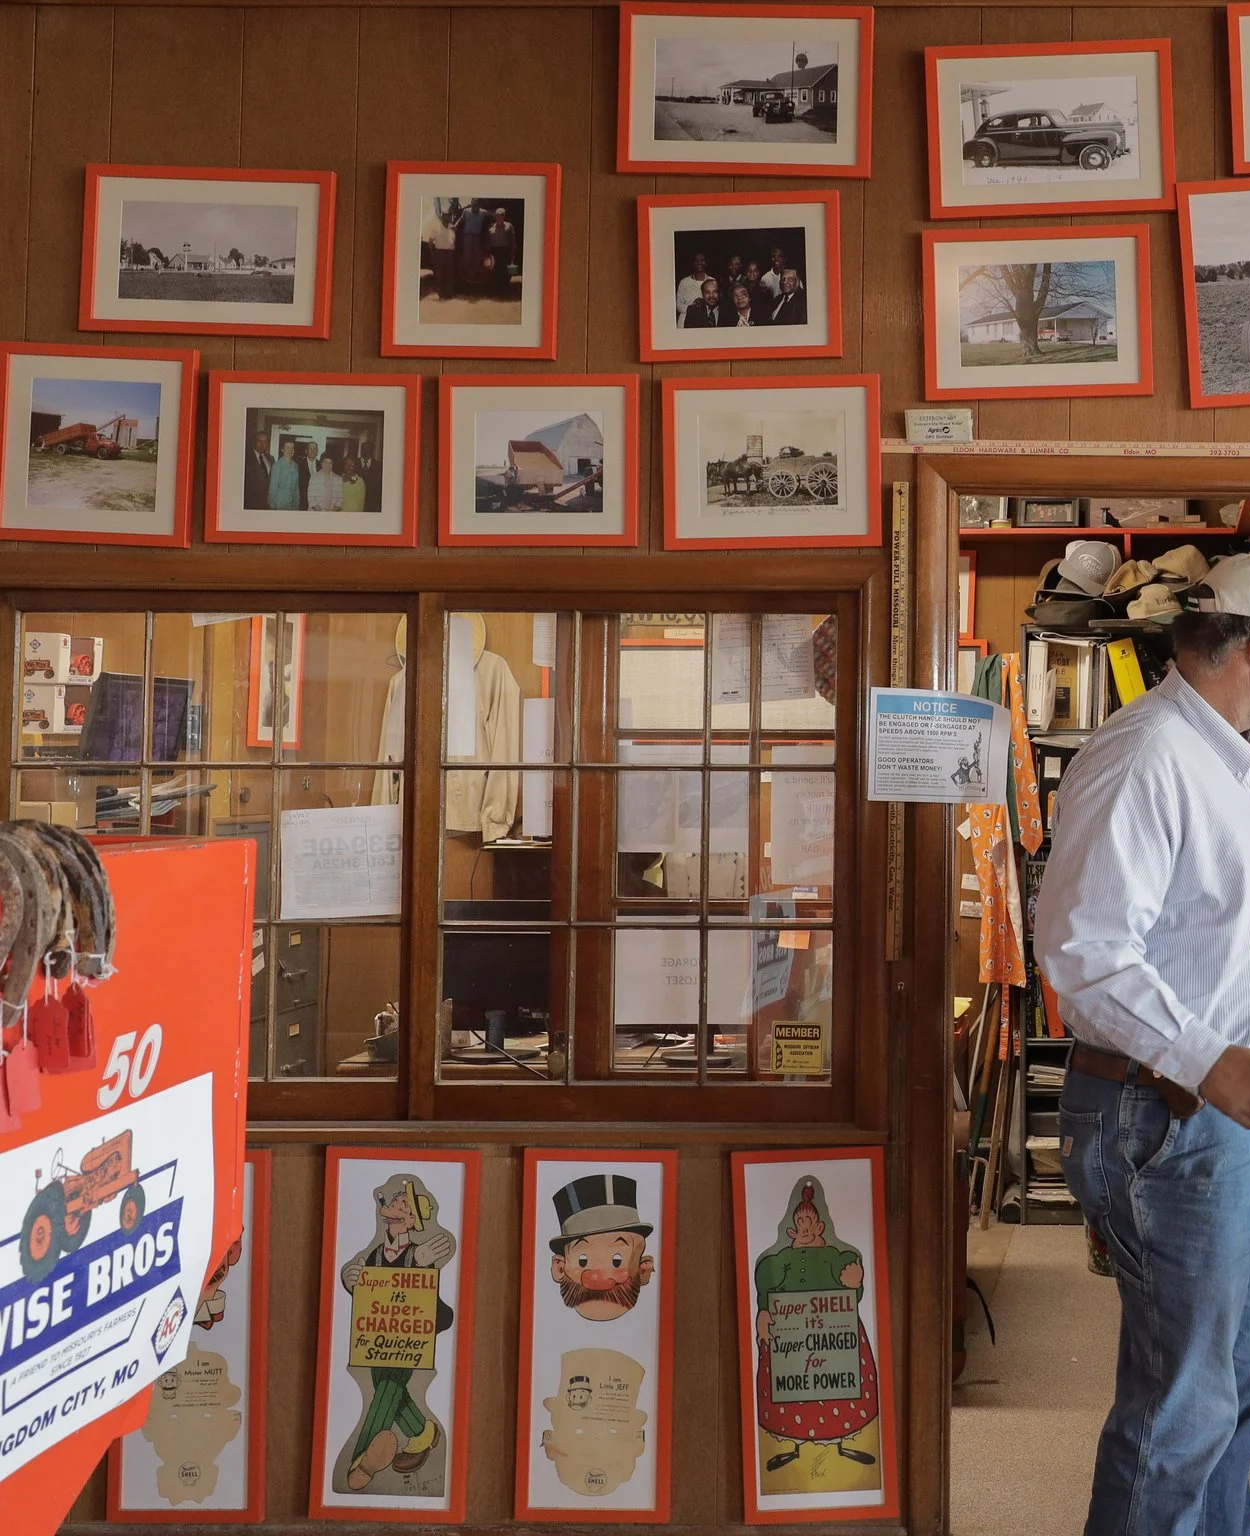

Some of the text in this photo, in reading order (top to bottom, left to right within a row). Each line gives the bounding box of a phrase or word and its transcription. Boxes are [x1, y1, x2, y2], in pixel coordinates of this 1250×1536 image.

[913, 701, 958, 713] NOTICE
[898, 757, 934, 765] OPERATORS
[775, 1027, 820, 1038] MEMBER
[97, 1023, 163, 1110] 50
[87, 1222, 174, 1308] BROS
[359, 1271, 436, 1293] Super SHELL
[390, 1291, 407, 1303] it's
[371, 1300, 424, 1318] Super-
[771, 1295, 854, 1320] Super SHELL
[355, 1316, 434, 1335] CHARGED
[18, 1358, 48, 1382] FRIEND
[51, 1350, 61, 1363] TO
[103, 1307, 137, 1334] FARMERS
[354, 1334, 429, 1350] for Quicker
[50, 1356, 73, 1376] SINCE
[365, 1347, 423, 1367] Starting
[804, 1352, 827, 1374] for
[111, 1358, 140, 1390] MO
[776, 1372, 857, 1392] MORE POWER
[616, 1383, 630, 1391] JEFF
